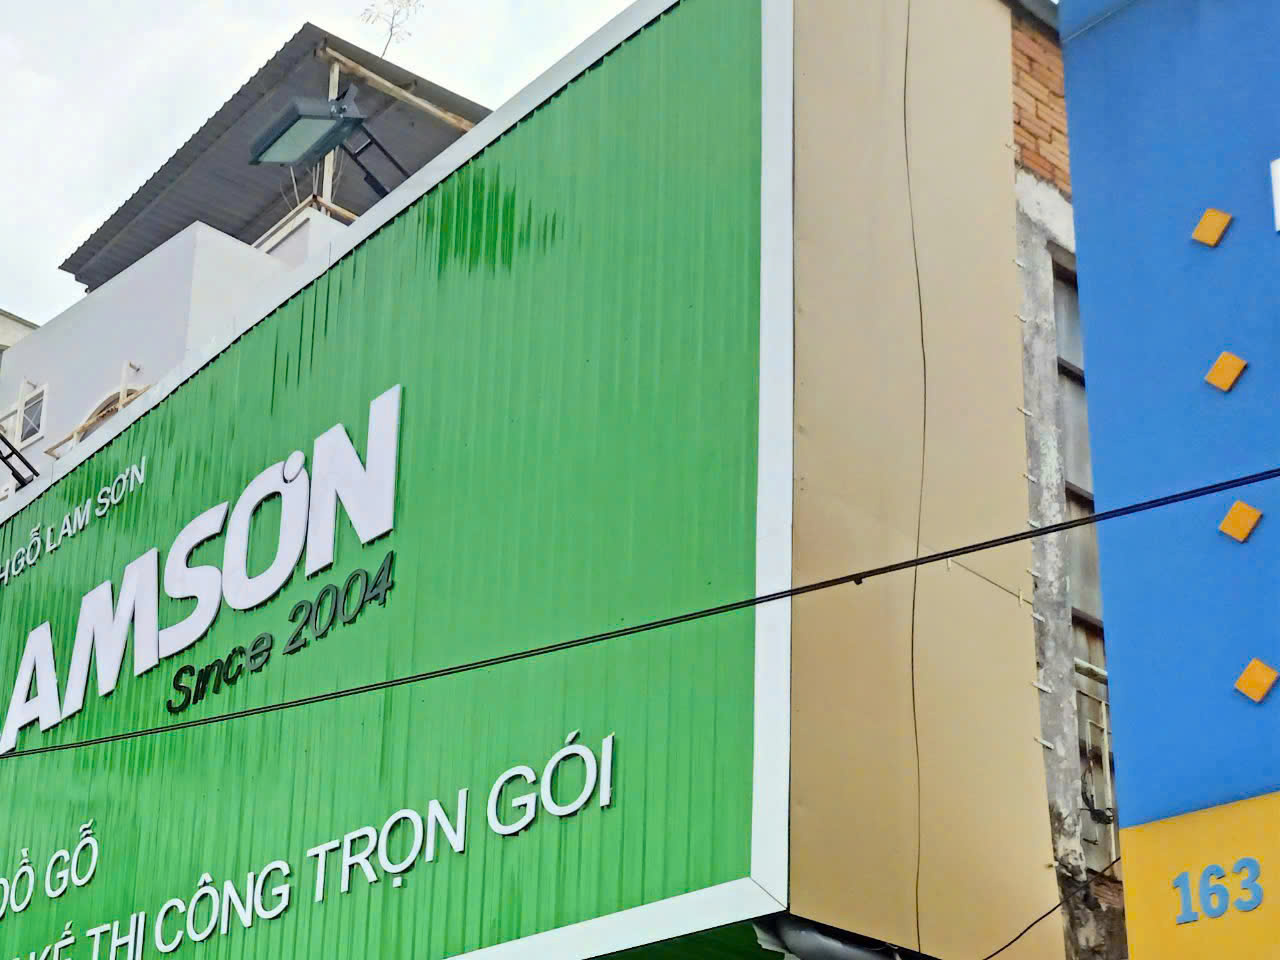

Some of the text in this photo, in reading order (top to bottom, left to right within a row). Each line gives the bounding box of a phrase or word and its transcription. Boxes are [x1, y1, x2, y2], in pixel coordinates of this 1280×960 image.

[11, 523, 41, 577] GỖ
[46, 498, 91, 554] LAM
[95, 456, 146, 517] SƠN
[166, 551, 395, 714] Since 2004
[44, 818, 100, 898] GỖ
[154, 872, 291, 954] CÔNG
[306, 787, 469, 902] TRỌN
[487, 729, 616, 836] GÓI
[1172, 857, 1265, 926] 163
